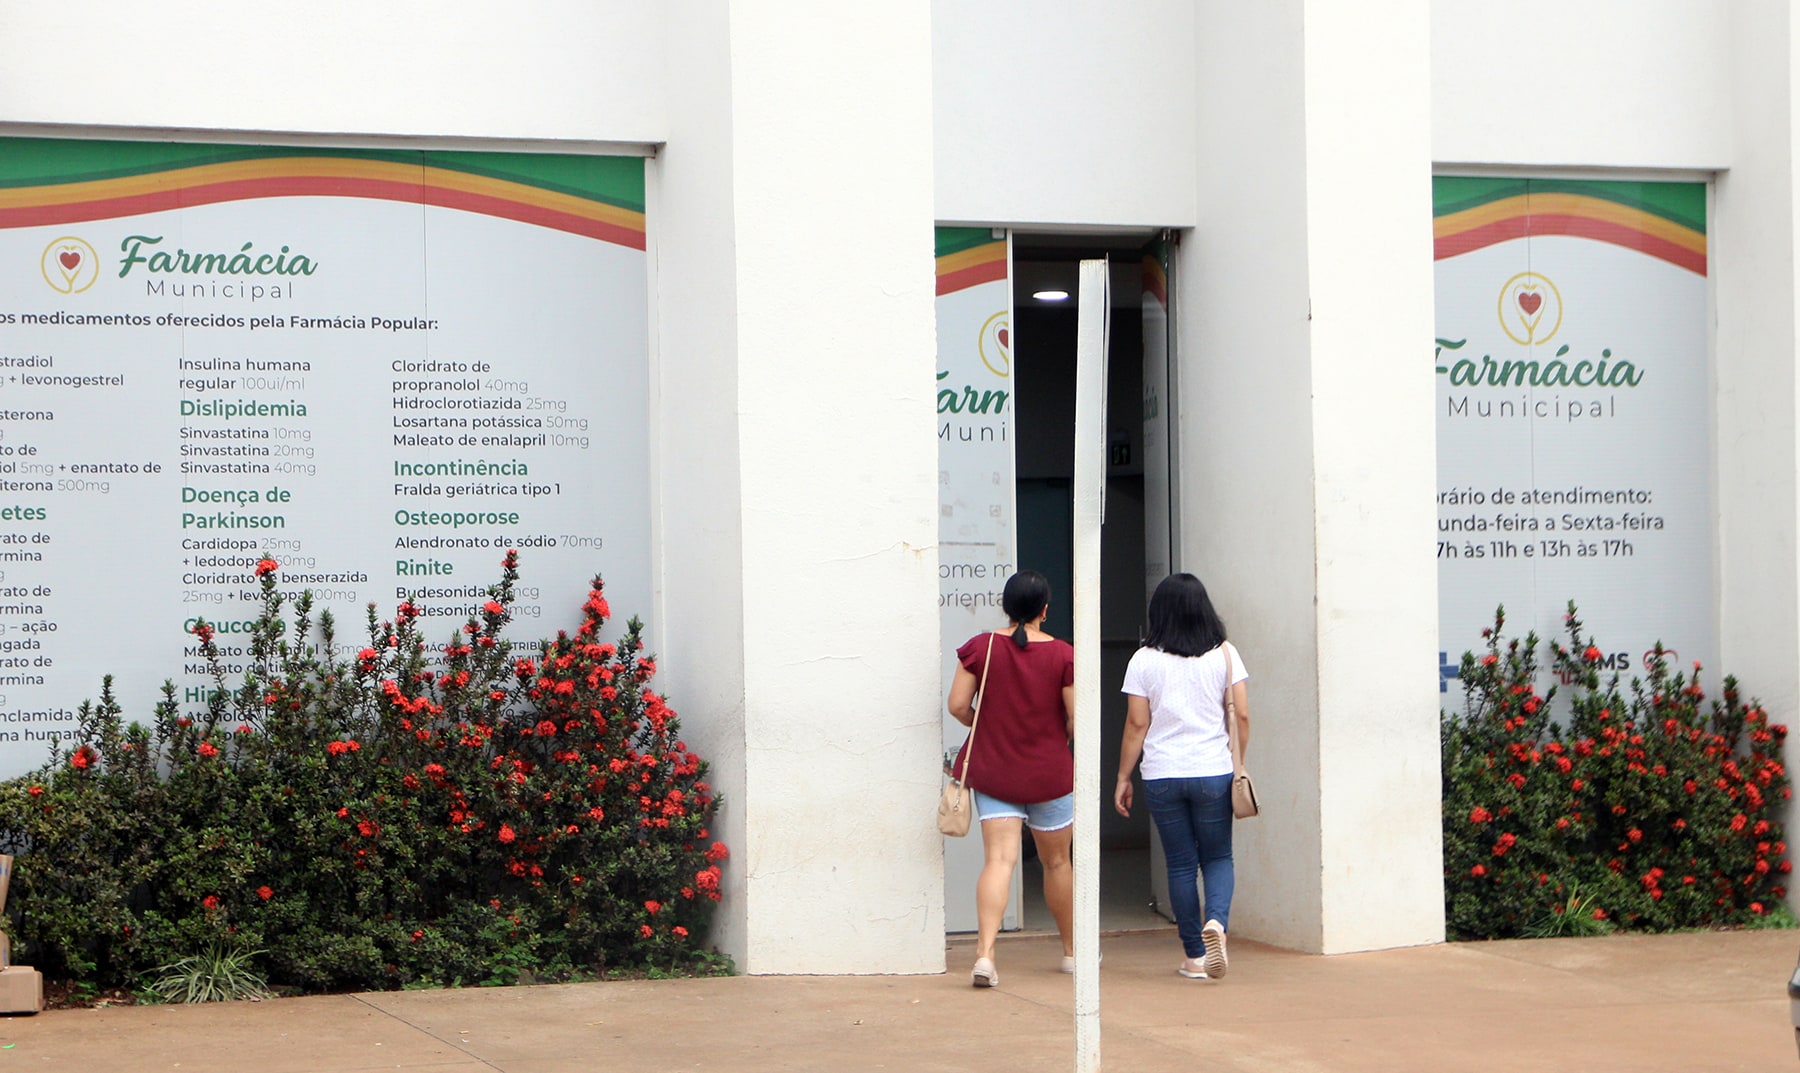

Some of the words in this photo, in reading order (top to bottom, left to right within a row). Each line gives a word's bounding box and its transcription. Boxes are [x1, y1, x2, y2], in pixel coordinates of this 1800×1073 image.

[118, 234, 318, 278] Farmácia
[146, 279, 293, 302] Municipal
[21, 311, 152, 326] medicamentos
[156, 312, 245, 328] oferecidos
[250, 314, 285, 331] pela
[290, 314, 366, 330] Farmácia
[371, 316, 439, 333] Popular:
[179, 357, 241, 371] Insulina
[246, 358, 311, 371] humana
[391, 360, 467, 373] Cloridrato
[471, 360, 491, 373] de
[9, 375, 17, 383] +
[21, 373, 124, 388] levonogestrel
[179, 377, 236, 392] regular
[241, 376, 305, 391] 100ui/ml
[392, 379, 480, 393] propranolol
[484, 379, 529, 394] 40mg
[180, 398, 307, 420] Dislipidemia
[392, 397, 522, 410] Hidroclorotiazida
[526, 397, 567, 413] 25mg
[1448, 395, 1615, 422] Municipal
[393, 415, 467, 428] Losartana
[472, 415, 542, 430] potássica
[546, 416, 589, 431] 50mg
[180, 427, 269, 439] Sinvastatina
[273, 427, 312, 441] 10mg
[393, 434, 454, 446] Maleato
[458, 434, 477, 446] de
[481, 434, 546, 449] enalapril
[550, 434, 590, 449] 10mg
[18, 444, 37, 456] de
[180, 444, 270, 456] Sinvastatina
[273, 444, 315, 459] 20mg
[20, 462, 54, 476] 5mg
[59, 464, 66, 472] +
[71, 462, 139, 473] enantato
[143, 462, 162, 473] de
[181, 461, 270, 473] Sinvastatina
[274, 462, 316, 476] 40mg
[394, 459, 528, 476] Incontinência
[57, 480, 110, 494] 500mg
[394, 483, 441, 495] Fralda
[446, 482, 518, 498] geriátrica
[522, 483, 551, 497] tipo
[555, 483, 561, 495] 1
[181, 486, 259, 507] Doença
[265, 486, 291, 503] de
[1491, 487, 1515, 505] de
[1521, 486, 1652, 505] atendimento:
[1, 505, 47, 520] etes
[182, 511, 285, 529] Parkinson
[394, 509, 520, 528] Osteoporose
[1438, 513, 1539, 532] unda-feira
[1545, 518, 1555, 531] a
[1561, 512, 1664, 531] Sexta-feira
[32, 532, 51, 544] de
[182, 537, 258, 552] Cardidopa
[261, 538, 301, 552] 25mg
[394, 536, 490, 549] Alendronato
[494, 535, 512, 548] de
[516, 534, 557, 548] sódio
[560, 535, 603, 550] 70mg
[1464, 540, 1485, 558] às
[1490, 541, 1517, 558] 11h
[1523, 546, 1534, 558] e
[1540, 540, 1571, 558] 13h
[1577, 539, 1598, 557] às
[1602, 539, 1633, 557] 17h
[183, 557, 190, 565] +
[269, 555, 316, 568] 50mg
[395, 558, 453, 576] Rinite
[182, 572, 255, 585] Cloridrato
[282, 571, 368, 584] benserazida
[32, 585, 52, 597] de
[183, 590, 223, 604] 25mg
[228, 592, 235, 600] +
[396, 585, 486, 599] Budesonida
[396, 604, 486, 618] desonida
[22, 620, 58, 634] ação
[33, 655, 53, 667] de
